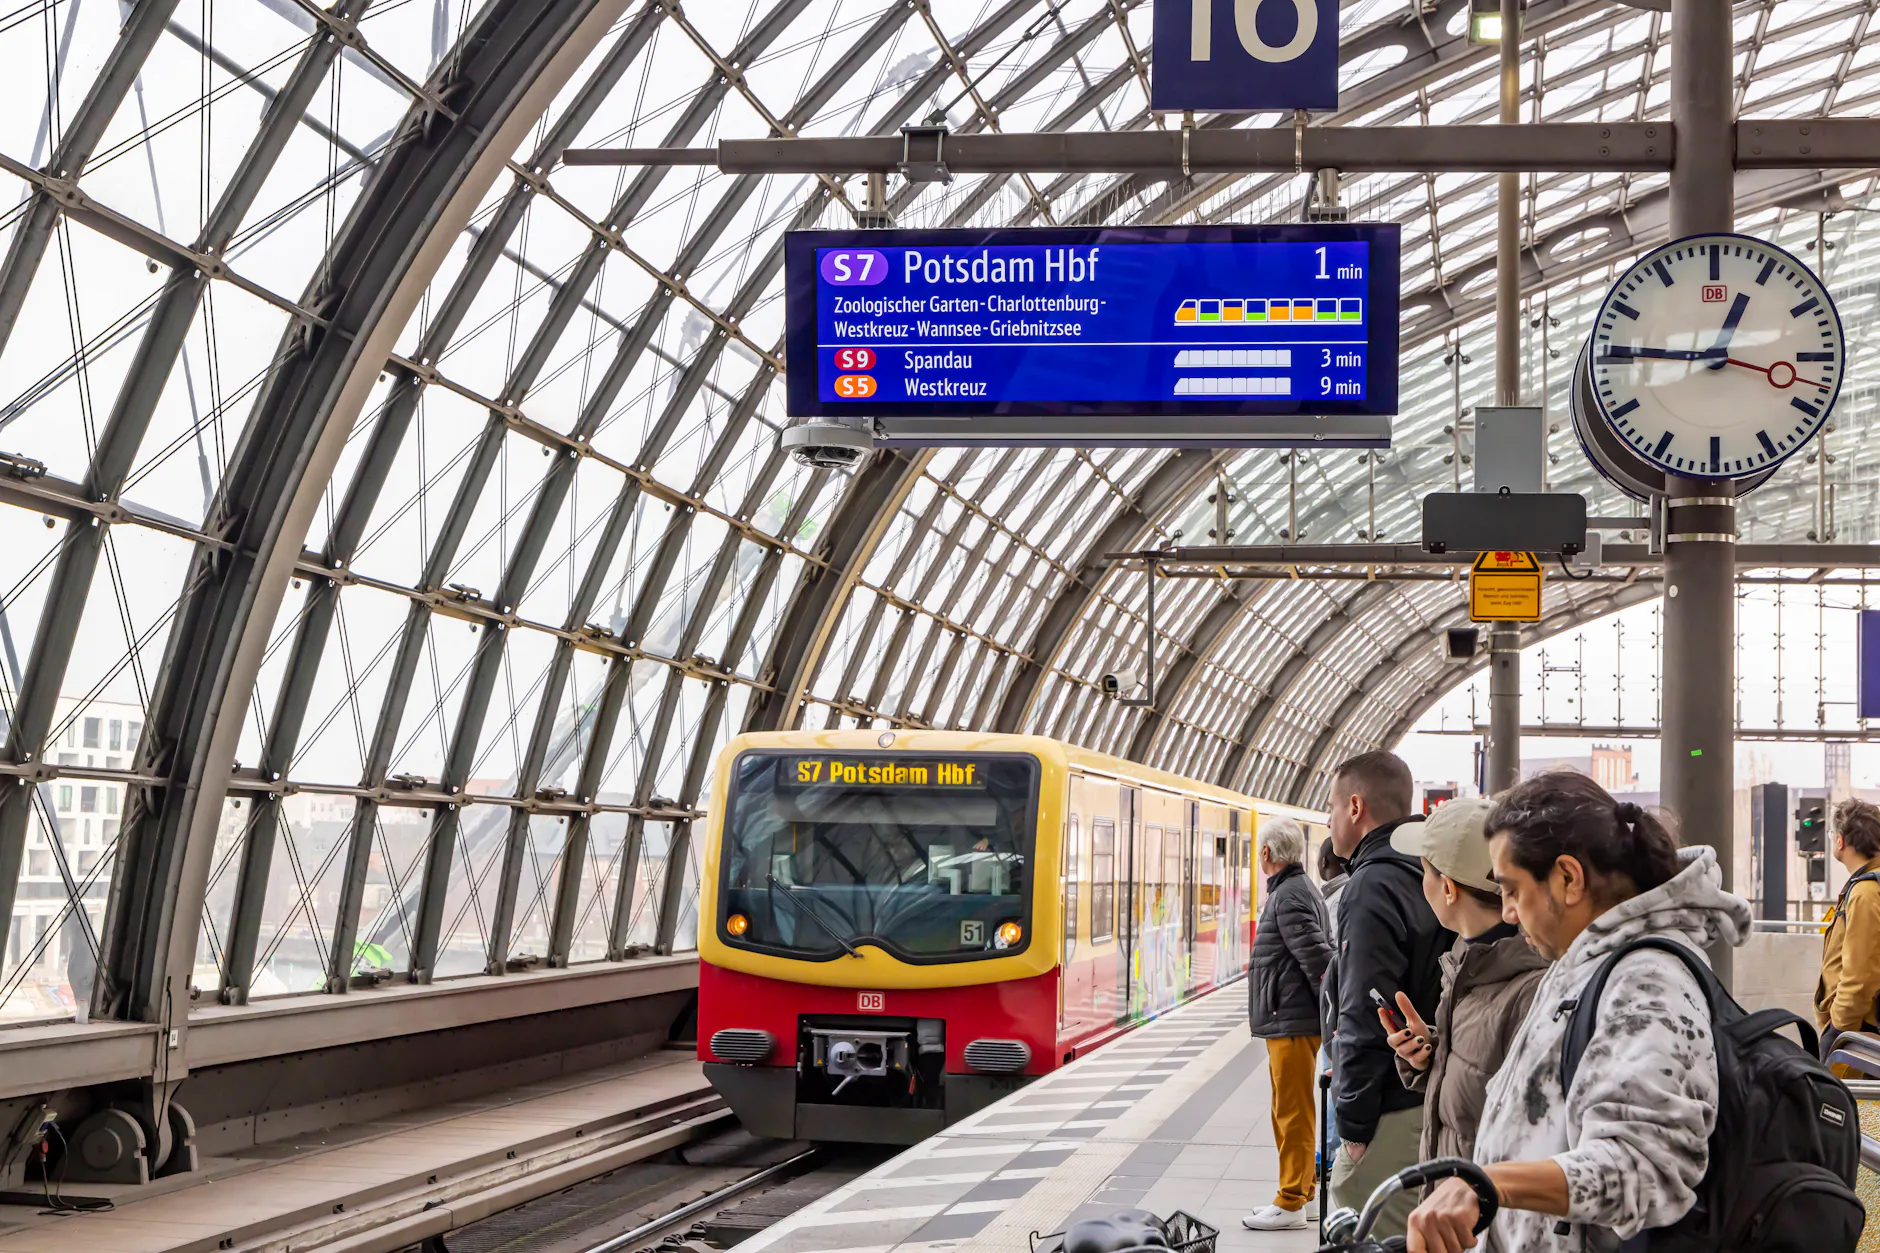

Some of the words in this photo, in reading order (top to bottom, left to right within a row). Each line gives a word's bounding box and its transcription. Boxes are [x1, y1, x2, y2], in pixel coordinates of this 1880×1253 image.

[905, 249, 1034, 284] Potsdam
[1045, 248, 1100, 283] Hbf
[1315, 247, 1330, 280] 1
[1338, 264, 1363, 280] min
[1706, 288, 1723, 300] DB
[834, 296, 926, 317] Zoologischer
[904, 351, 973, 373] Spandau
[1320, 348, 1331, 368] 3
[1336, 351, 1362, 367] min
[904, 377, 987, 397] Westkreuz
[1320, 376, 1332, 396] 9
[1335, 379, 1361, 395] min
[798, 761, 823, 783] S7
[830, 761, 928, 785] Potsdam
[964, 924, 982, 942] 51
[861, 995, 881, 1008] DB
